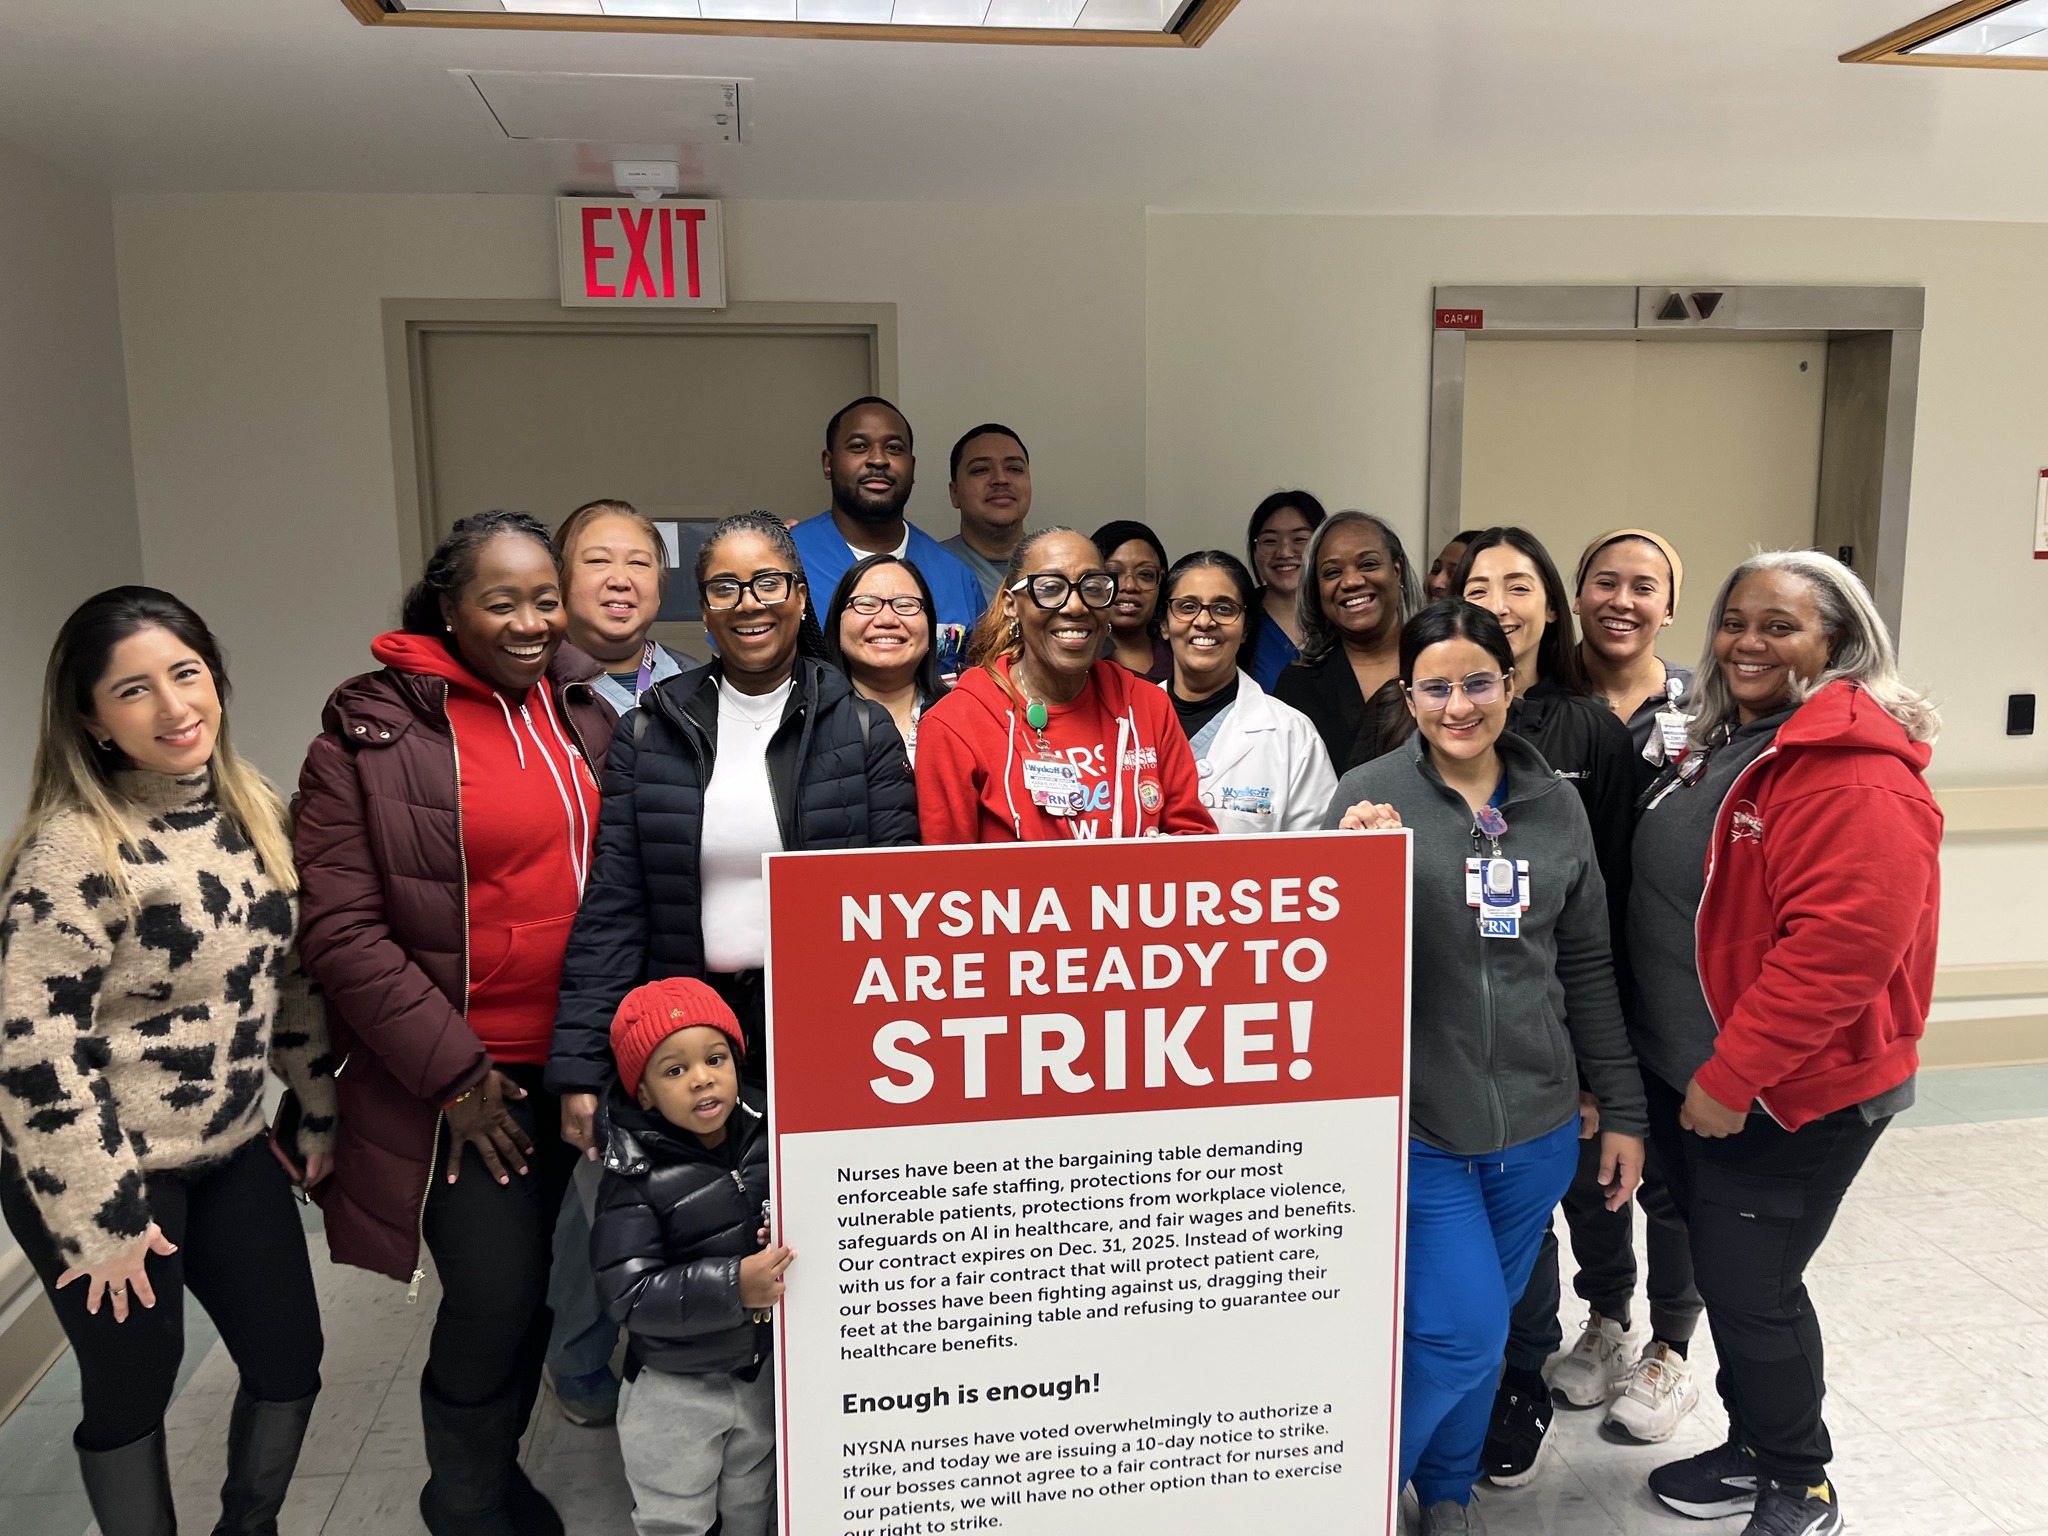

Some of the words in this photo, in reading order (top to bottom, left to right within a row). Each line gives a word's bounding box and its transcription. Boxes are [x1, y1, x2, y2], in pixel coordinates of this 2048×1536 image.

[581, 207, 706, 298] EXIT
[1048, 794, 1067, 805] RN
[841, 888, 1072, 942] NYSNA
[1091, 876, 1340, 931] NURSES
[1487, 920, 1512, 933] RN
[852, 952, 985, 1005] ARE
[1009, 942, 1229, 996] READY
[1243, 938, 1328, 985] TO
[869, 1001, 1314, 1104] STRIKE!
[837, 1167, 900, 1183] Nurses
[905, 1163, 948, 1179] have
[953, 1160, 998, 1175] been
[1002, 1157, 1020, 1172] at
[1024, 1155, 1054, 1170] the
[1059, 1149, 1153, 1170] bargaining
[1157, 1145, 1202, 1161] table
[1206, 1139, 1303, 1158] demanding
[837, 1184, 947, 1206] enforceable
[951, 1181, 988, 1198] safe
[992, 1177, 1065, 1195] staffing,
[1070, 1170, 1172, 1193] protections
[1176, 1167, 1202, 1182] for
[1205, 1167, 1237, 1180] our
[1240, 1162, 1284, 1178] most
[837, 1207, 935, 1228] vulnerable
[939, 1203, 1017, 1225] patients,
[1022, 1195, 1125, 1219] protections
[1128, 1192, 1171, 1208] from
[1175, 1186, 1266, 1205] workplace
[1269, 1181, 1346, 1198] violence,
[838, 1229, 938, 1252] safeguards
[942, 1230, 966, 1243] on
[970, 1225, 988, 1241] AI
[993, 1224, 1010, 1239] in
[1015, 1219, 1114, 1238] healthcare,
[1118, 1213, 1151, 1230] and
[1155, 1211, 1185, 1228] fair
[1188, 1210, 1243, 1227] wages
[1247, 1204, 1279, 1221] and
[1284, 1200, 1356, 1218] benefits.
[838, 1257, 875, 1273] Our
[878, 1251, 957, 1270] contract
[961, 1246, 1026, 1266] expires
[1029, 1246, 1053, 1259] on
[1058, 1241, 1097, 1257] Dec.
[1102, 1237, 1127, 1254] 31,
[1131, 1233, 1180, 1251] 2025.
[1185, 1228, 1247, 1247] Instead
[1251, 1226, 1271, 1242] of
[1273, 1222, 1343, 1240] working
[838, 1278, 879, 1295] with
[884, 1279, 905, 1292] us
[909, 1274, 937, 1290] for
[940, 1276, 951, 1287] a
[955, 1270, 986, 1286] fair
[989, 1265, 1066, 1284] contract
[1070, 1261, 1106, 1277] that
[1110, 1258, 1142, 1274] will
[1146, 1253, 1210, 1275] protect
[1214, 1249, 1275, 1270] patient
[1278, 1248, 1319, 1261] care,
[839, 1303, 872, 1317] our
[876, 1298, 937, 1314] bosses
[942, 1294, 984, 1309] have
[989, 1291, 1033, 1305] been
[1037, 1283, 1106, 1304] fighting
[1110, 1278, 1174, 1299] against
[1178, 1278, 1202, 1291] us,
[1206, 1270, 1283, 1290] dragging
[1287, 1265, 1328, 1282] their
[839, 1323, 876, 1339] feet
[880, 1321, 898, 1336] at
[902, 1318, 933, 1334] the
[937, 1311, 1033, 1333] bargaining
[1037, 1306, 1082, 1323] table
[1086, 1302, 1119, 1319] and
[1123, 1298, 1194, 1316] refusing
[1198, 1297, 1217, 1310] to
[1221, 1290, 1307, 1312] guarantee
[1311, 1288, 1341, 1301] our
[840, 1342, 937, 1361] healthcare
[942, 1334, 1018, 1353] benefits.
[842, 1386, 950, 1415] Enough
[958, 1383, 979, 1405] is
[985, 1372, 1100, 1402] enough!
[842, 1462, 897, 1479] strike,
[901, 1456, 935, 1474] and
[939, 1453, 991, 1470] today
[994, 1452, 1021, 1465] we
[1025, 1449, 1053, 1462] are
[1057, 1442, 1117, 1459] issuing
[1121, 1442, 1131, 1453] a
[1136, 1434, 1195, 1452] 10-day
[1199, 1429, 1253, 1446] notice
[1257, 1427, 1275, 1440] to
[1279, 1422, 1329, 1439] strike.
[843, 1438, 906, 1458] NYSNA
[911, 1436, 969, 1452] nurses
[974, 1431, 1015, 1446] have
[1019, 1423, 1069, 1441] voted
[1074, 1411, 1213, 1437] overwhelmingly
[1216, 1411, 1235, 1424] to
[1238, 1404, 1319, 1422] authorize
[1322, 1403, 1332, 1414] a
[843, 1484, 856, 1500] If
[860, 1485, 892, 1498] our
[896, 1479, 956, 1495] bosses
[960, 1470, 1022, 1489] cannot
[1026, 1468, 1076, 1485] agree
[1080, 1464, 1099, 1478] to
[1102, 1464, 1112, 1476] a
[1117, 1458, 1146, 1474] fair
[1149, 1452, 1222, 1471] contract
[1226, 1449, 1251, 1464] for
[1255, 1446, 1309, 1461] nurses
[1313, 1439, 1344, 1456] and
[843, 1507, 875, 1521] our
[879, 1499, 955, 1521] patients,
[960, 1497, 986, 1510] we
[990, 1490, 1022, 1507] will
[1026, 1489, 1067, 1503] have
[1072, 1487, 1094, 1499] no
[1098, 1480, 1146, 1496] other
[1149, 1475, 1206, 1494] option
[1210, 1471, 1248, 1486] than
[1252, 1469, 1271, 1481] to
[1274, 1461, 1342, 1479] exercise
[879, 1522, 922, 1536] right
[926, 1521, 946, 1534] to
[950, 1514, 1003, 1532] strike.
